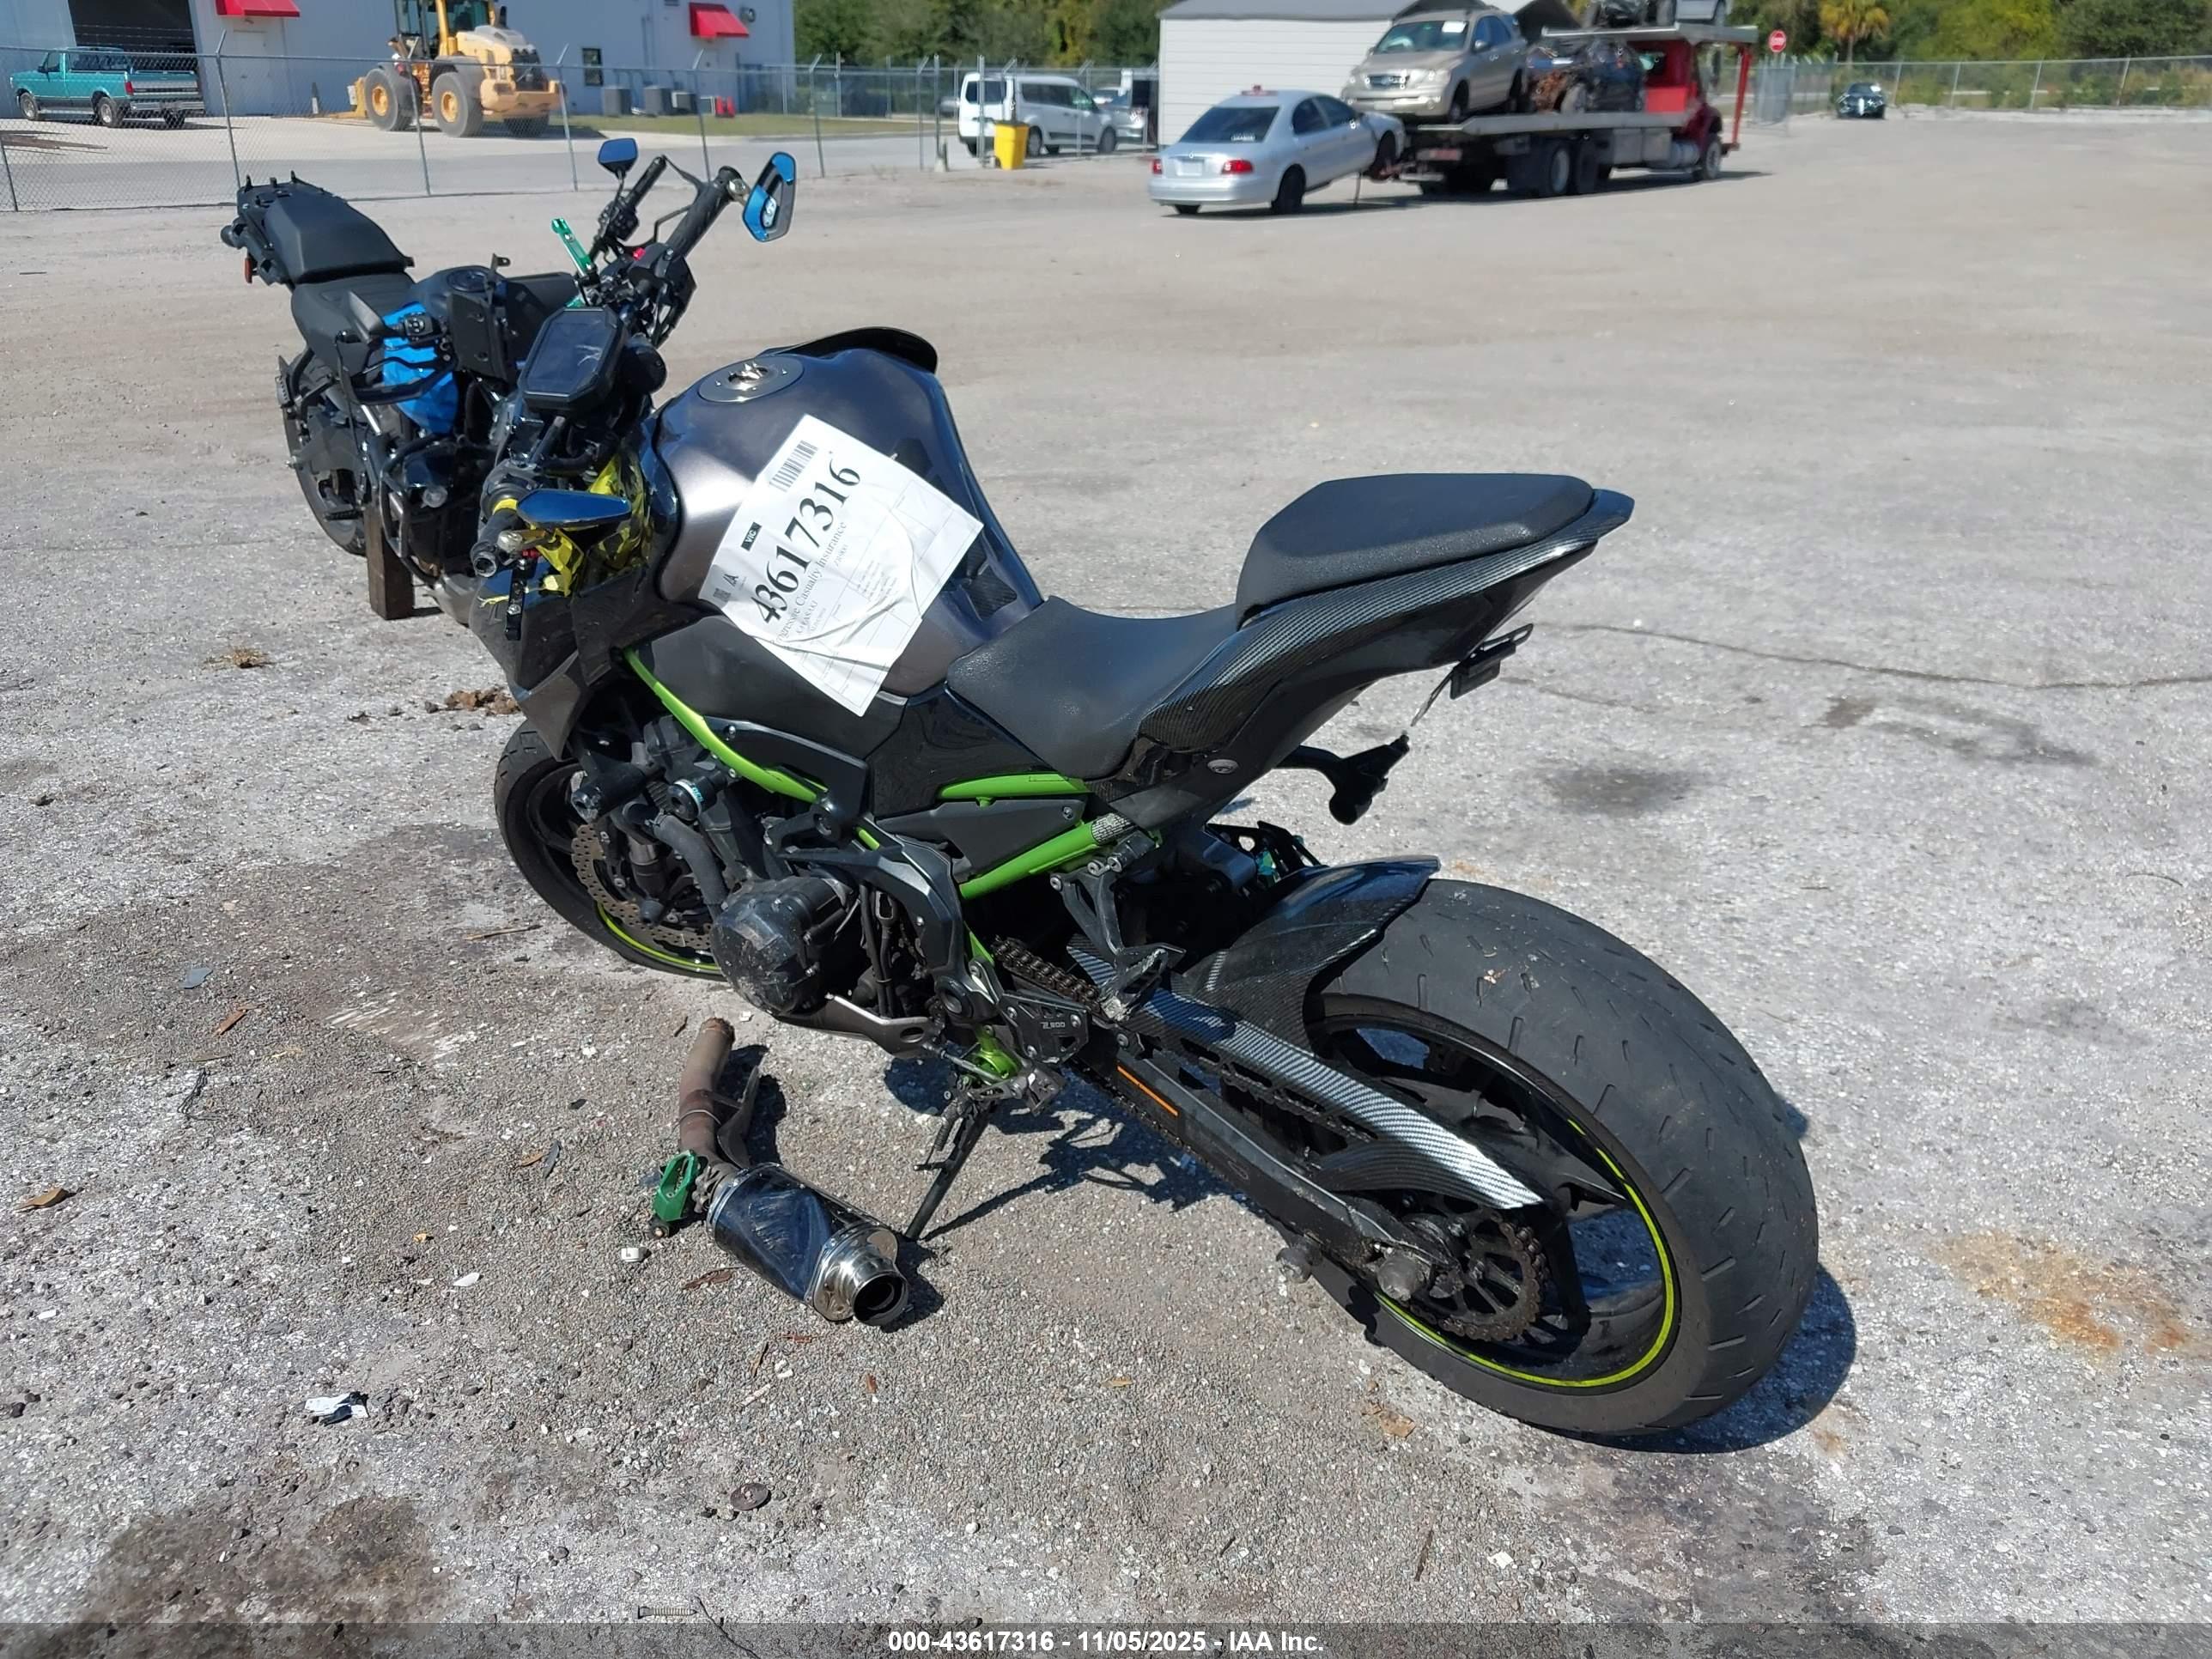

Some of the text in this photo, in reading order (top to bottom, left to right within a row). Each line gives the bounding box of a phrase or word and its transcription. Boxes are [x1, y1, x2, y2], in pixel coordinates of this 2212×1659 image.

[744, 530, 757, 543] VIC
[750, 458, 860, 624] 43617316
[795, 568, 823, 606] Casualty
[817, 522, 847, 568] Insurance
